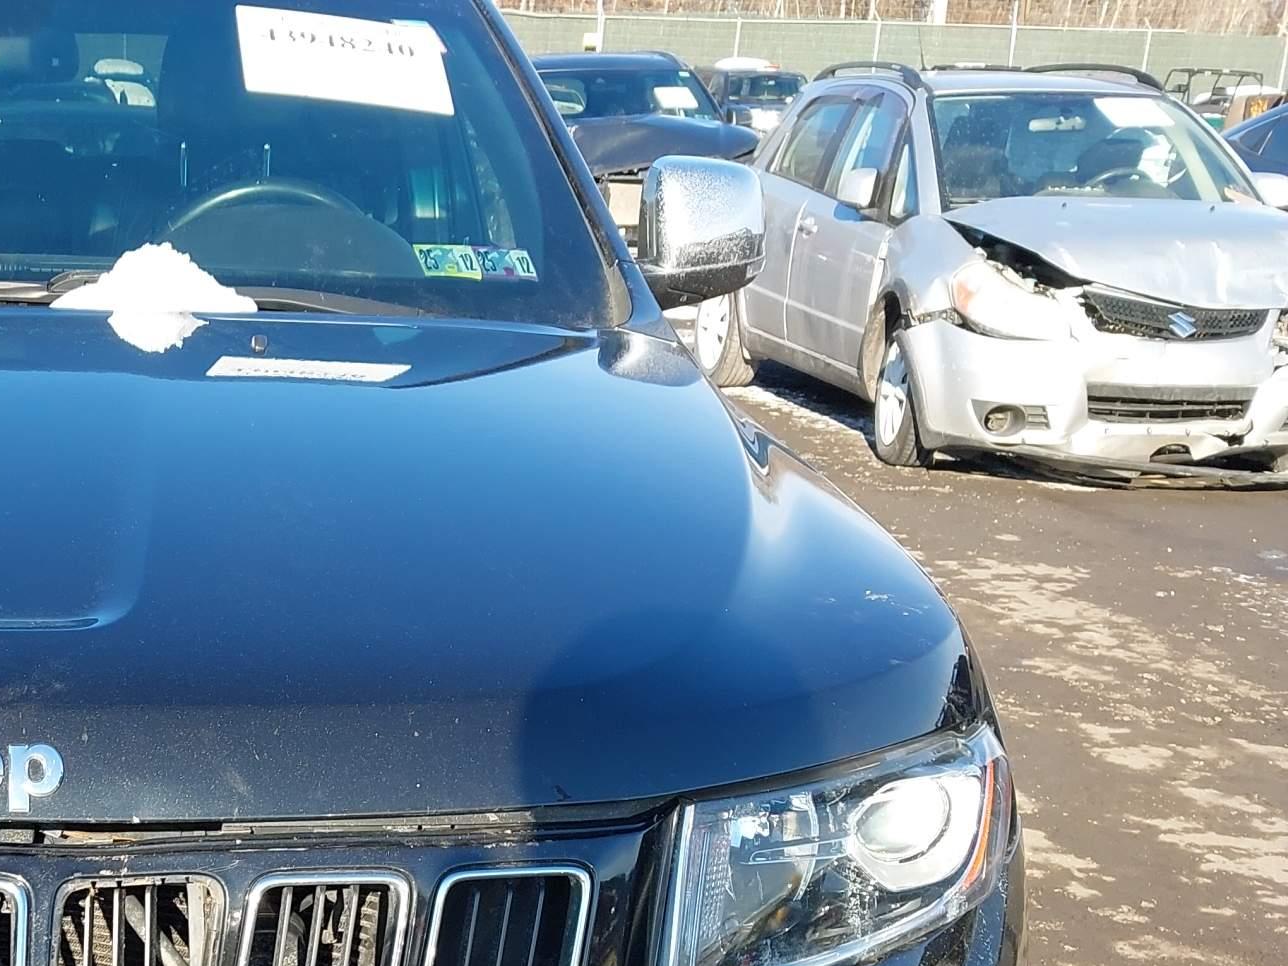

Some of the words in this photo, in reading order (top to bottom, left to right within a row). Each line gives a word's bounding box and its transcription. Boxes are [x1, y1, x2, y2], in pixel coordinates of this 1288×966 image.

[417, 249, 440, 271] 25
[458, 253, 477, 271] 12
[478, 250, 497, 272] 25
[515, 256, 534, 274] 12
